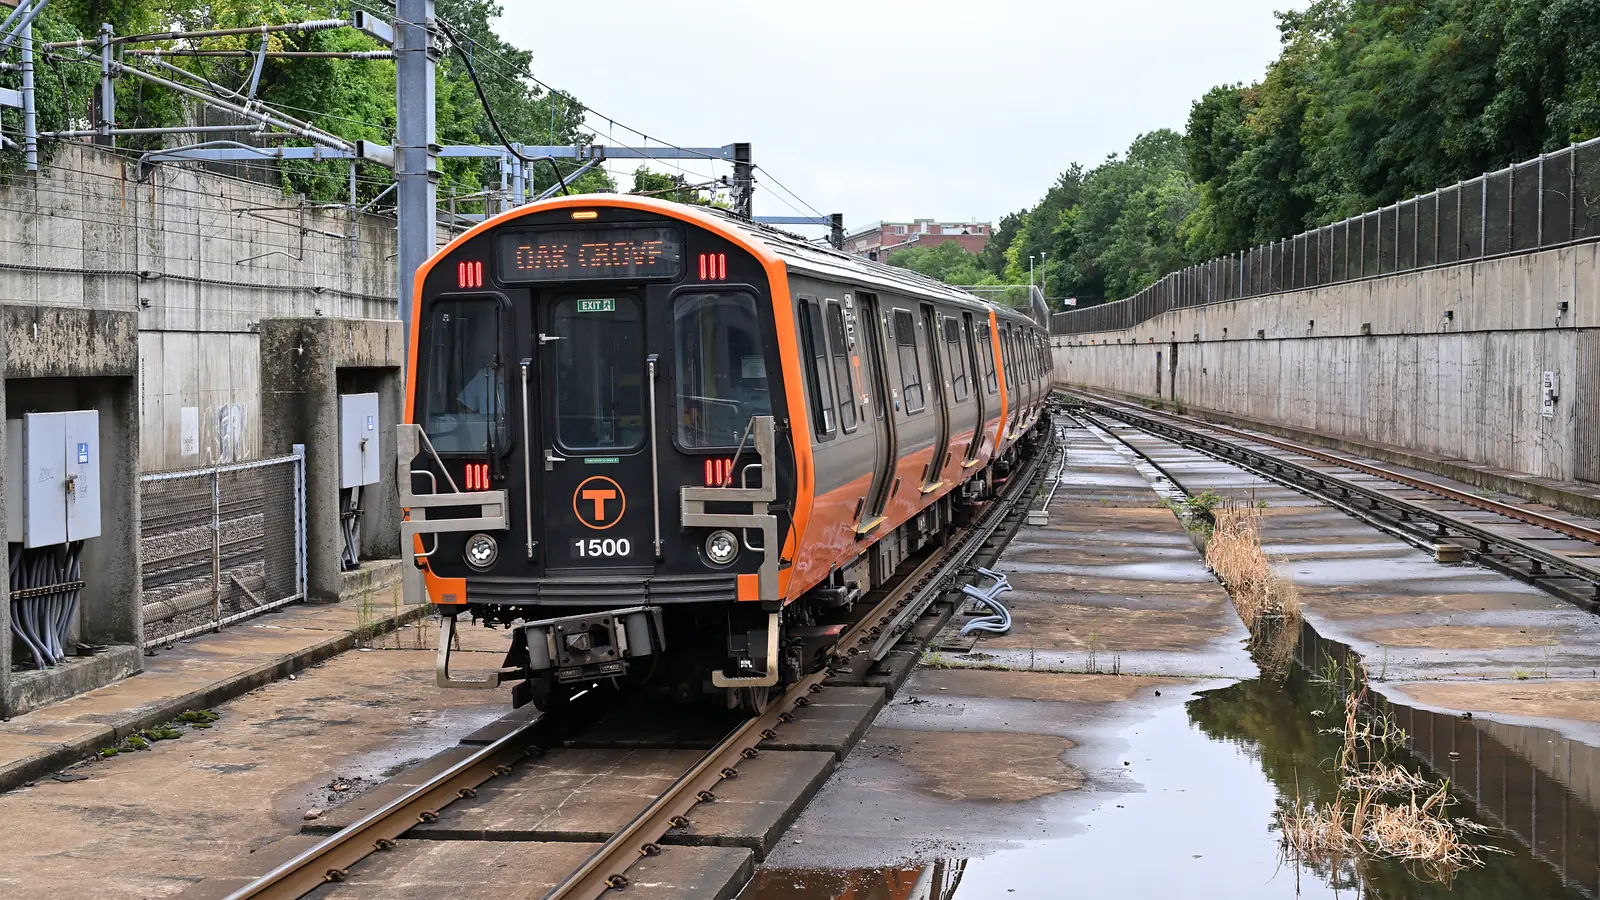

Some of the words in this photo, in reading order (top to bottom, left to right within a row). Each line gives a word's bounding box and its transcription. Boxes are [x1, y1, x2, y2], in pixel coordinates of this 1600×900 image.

[516, 244, 568, 269] OAK
[582, 300, 601, 310] EXIT
[582, 489, 617, 521] T
[575, 538, 630, 557] 1500
